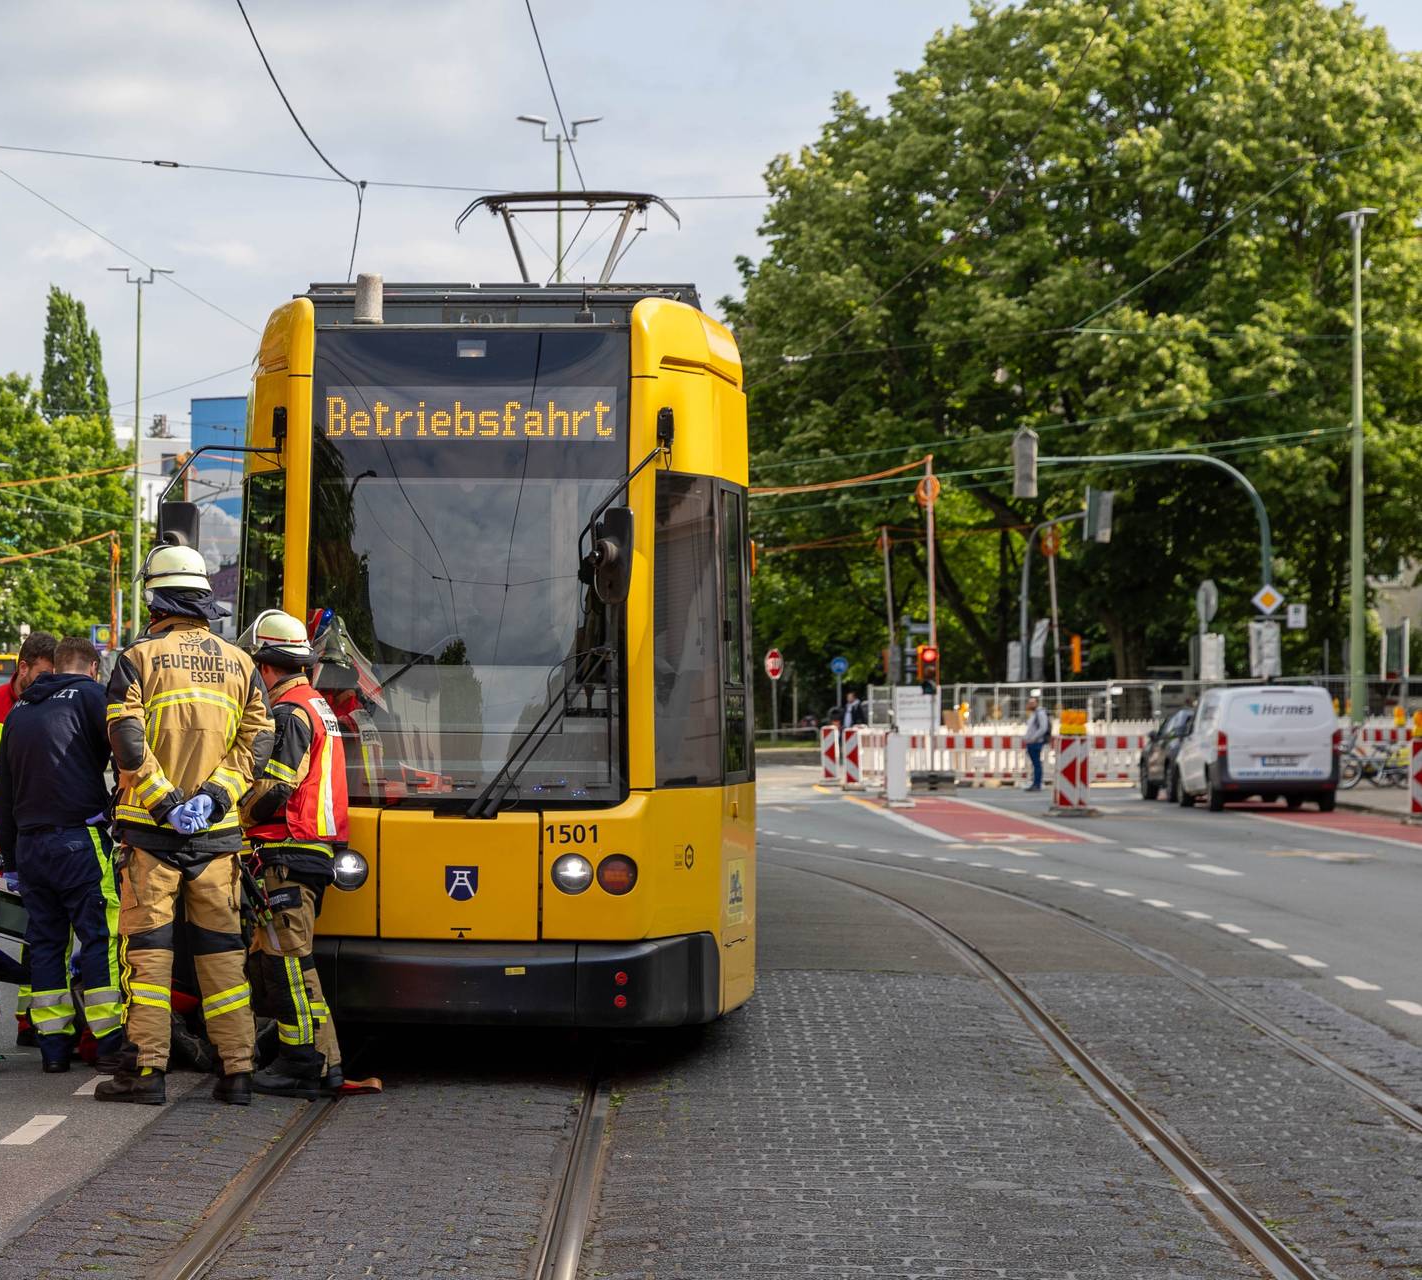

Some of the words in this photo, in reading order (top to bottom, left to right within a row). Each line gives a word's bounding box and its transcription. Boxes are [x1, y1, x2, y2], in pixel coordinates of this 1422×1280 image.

[326, 395, 613, 437] Betriebsfahrt
[151, 653, 242, 677] FEUERWEHR
[190, 671, 225, 683] ESSEN
[1261, 703, 1314, 716] Hermes
[545, 824, 599, 844] 1501
